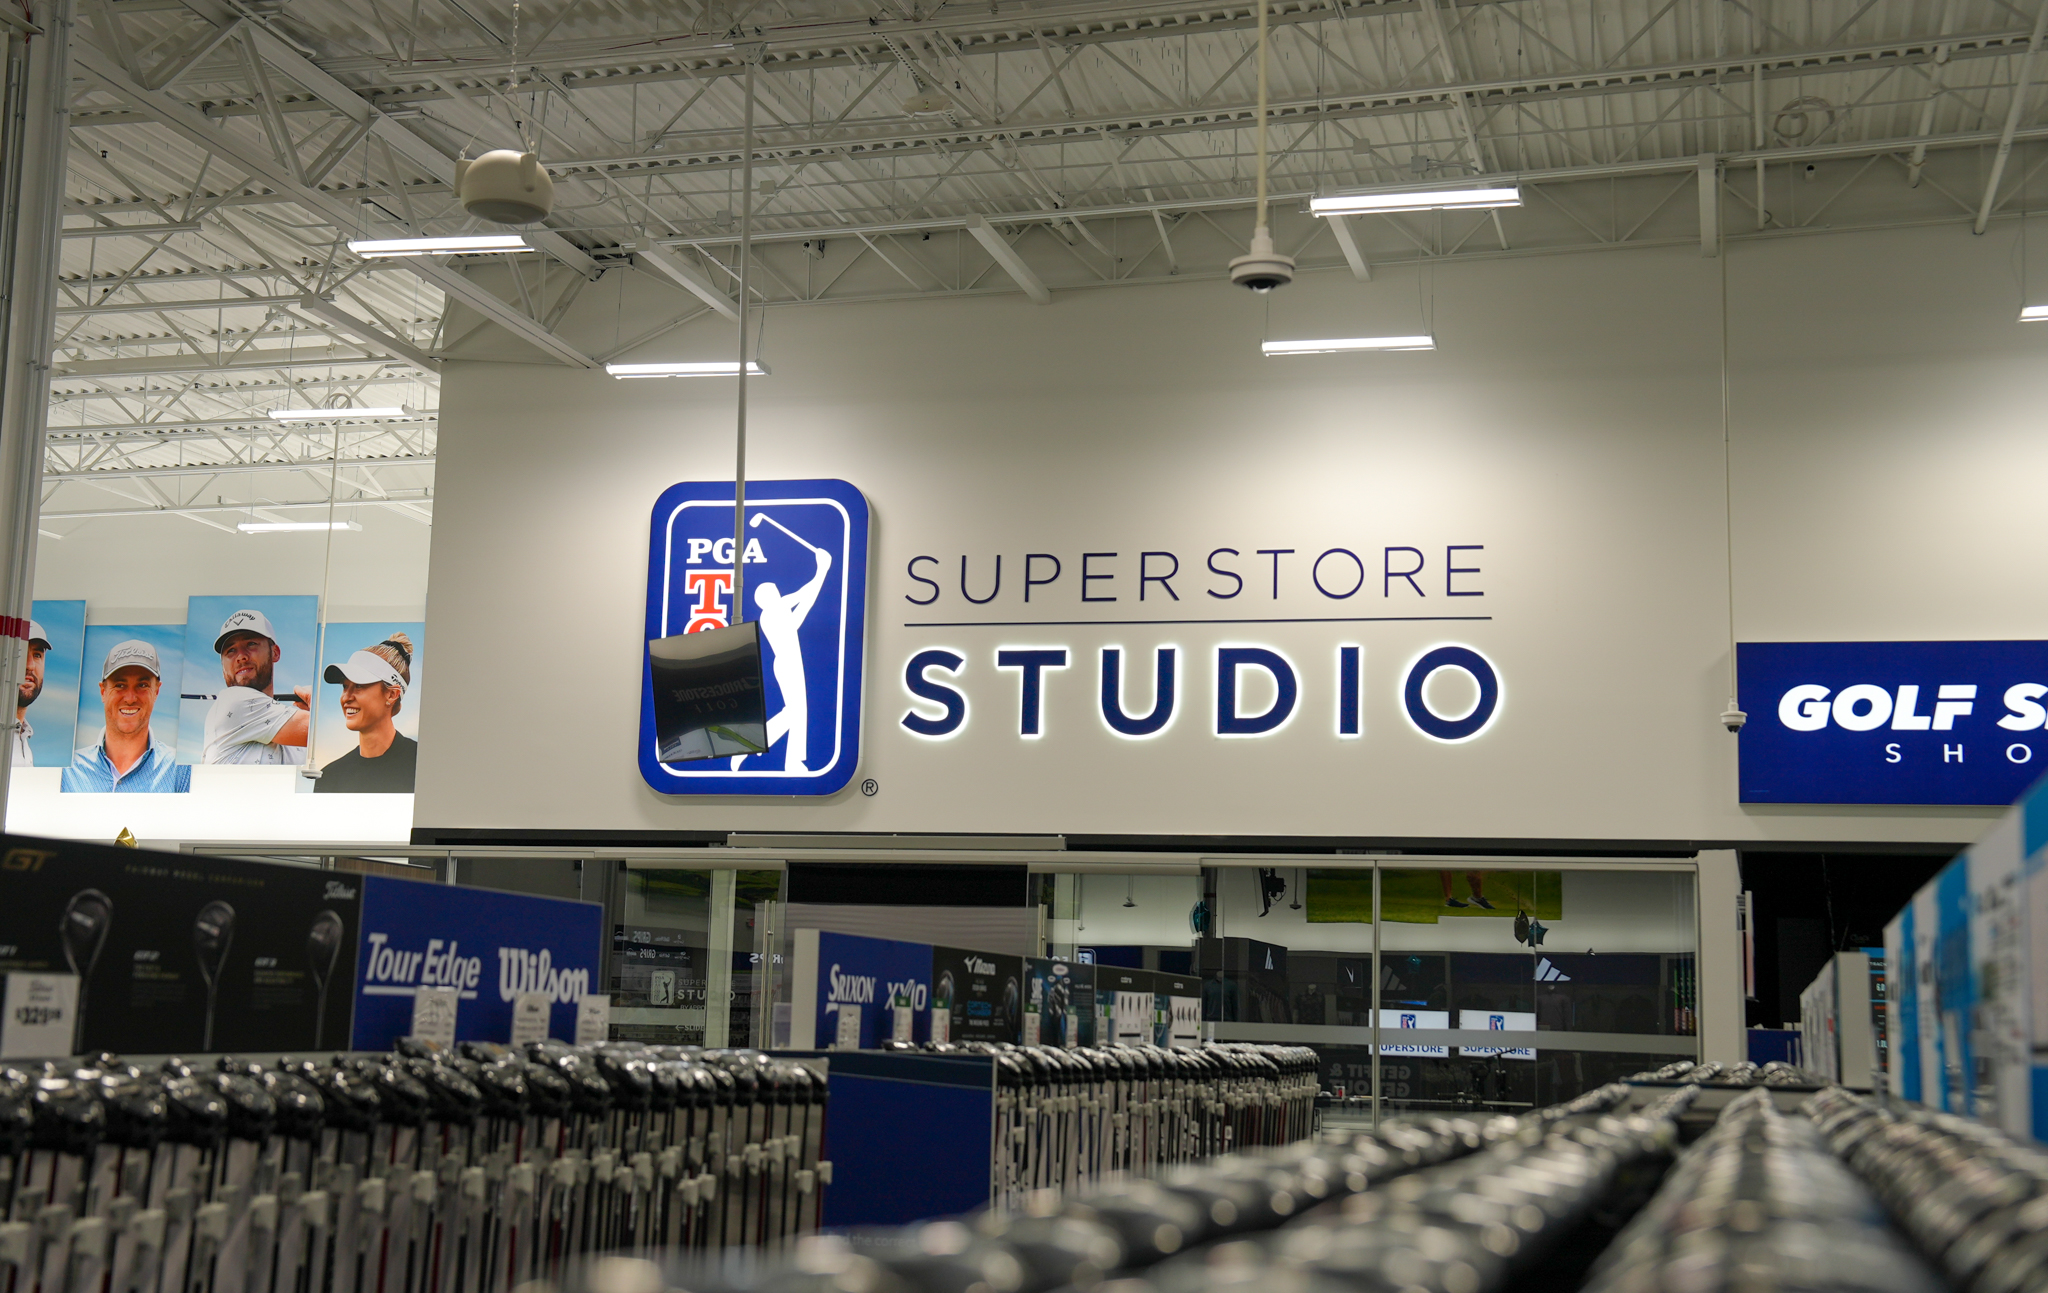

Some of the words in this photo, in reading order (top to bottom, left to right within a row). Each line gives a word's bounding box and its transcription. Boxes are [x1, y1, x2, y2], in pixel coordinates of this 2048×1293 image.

[687, 537, 767, 564] PGA
[904, 544, 1485, 606] SUPERSTORE
[224, 612, 256, 629] Callaway
[110, 646, 155, 664] Titleist
[900, 645, 1500, 741] STUDIO
[1778, 683, 1978, 732] GOLF
[1996, 682, 2048, 732] S
[2, 848, 57, 872] GT
[366, 932, 424, 983] Tour
[420, 938, 482, 998] Edge
[498, 946, 589, 1004] Wilson
[828, 963, 877, 1004] SRIXON
[1380, 1045, 1444, 1054] UPERSTORE
